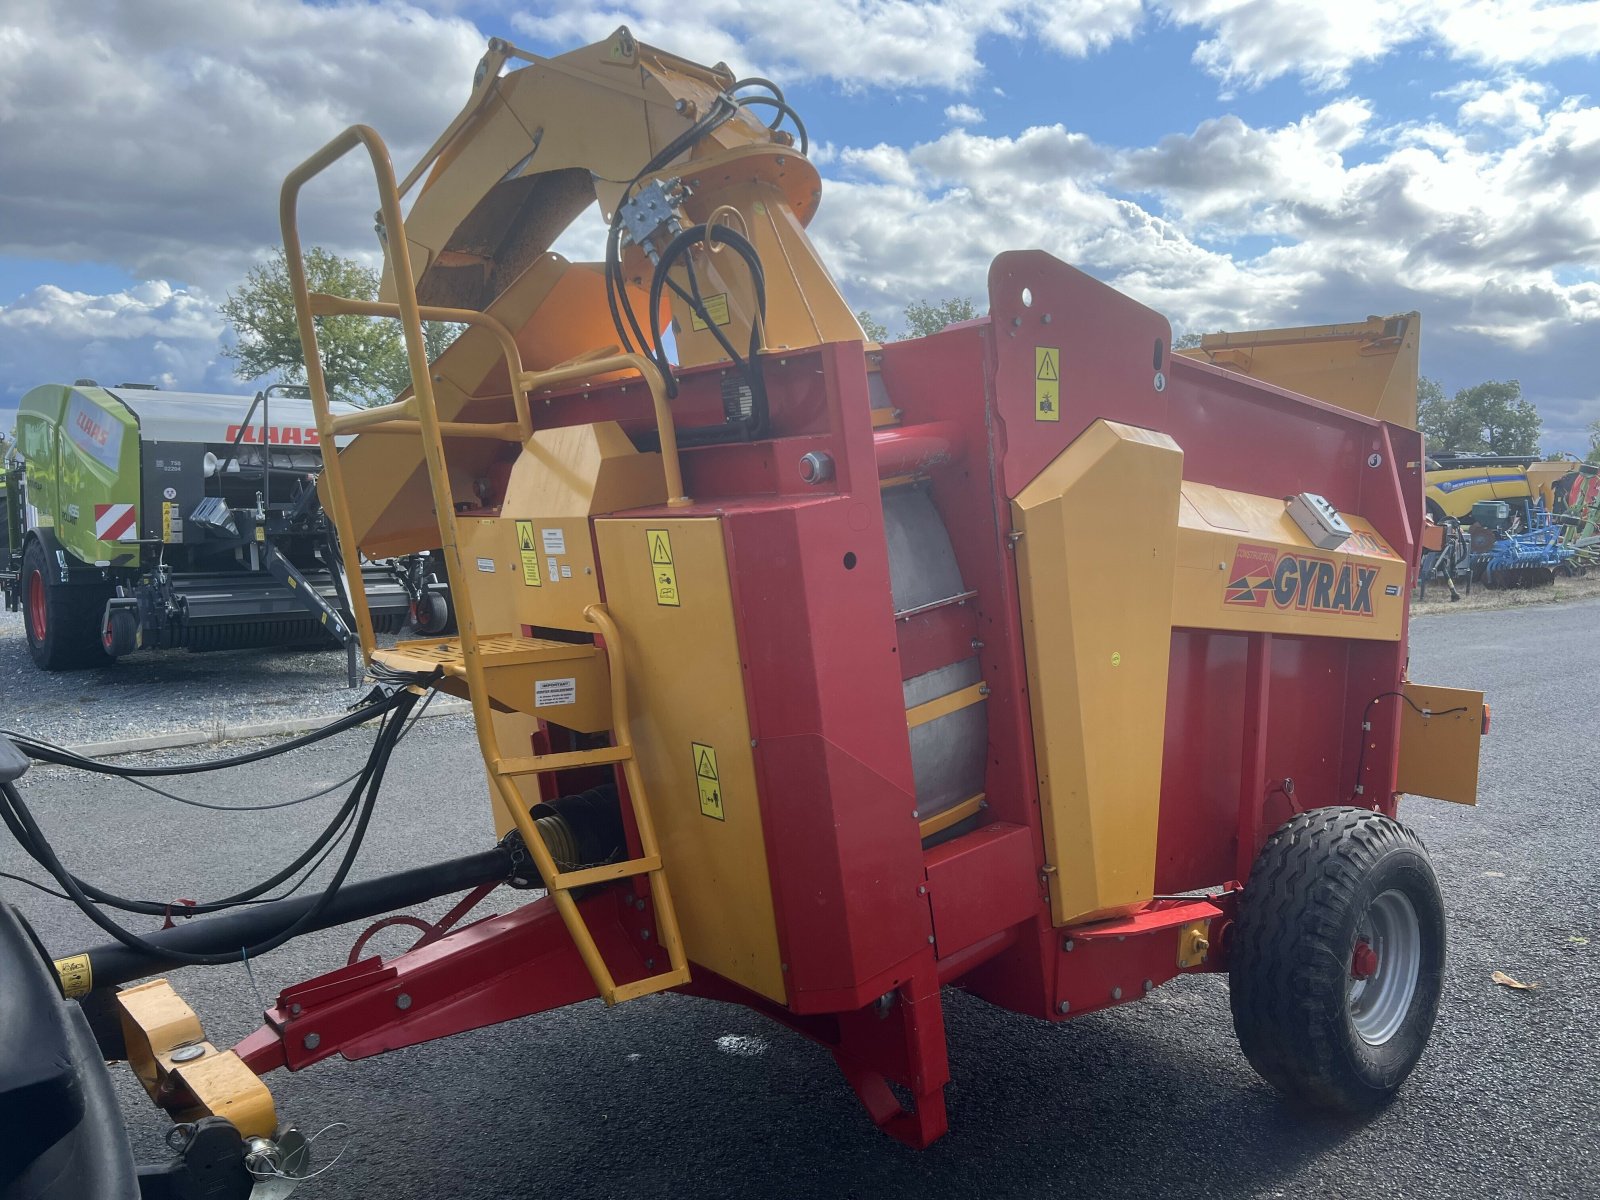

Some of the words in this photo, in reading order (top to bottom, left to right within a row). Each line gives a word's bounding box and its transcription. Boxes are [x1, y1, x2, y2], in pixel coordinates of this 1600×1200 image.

[76, 410, 110, 446] CLAAS
[225, 424, 320, 445] CLAAS
[1272, 555, 1379, 614] GYRAX
